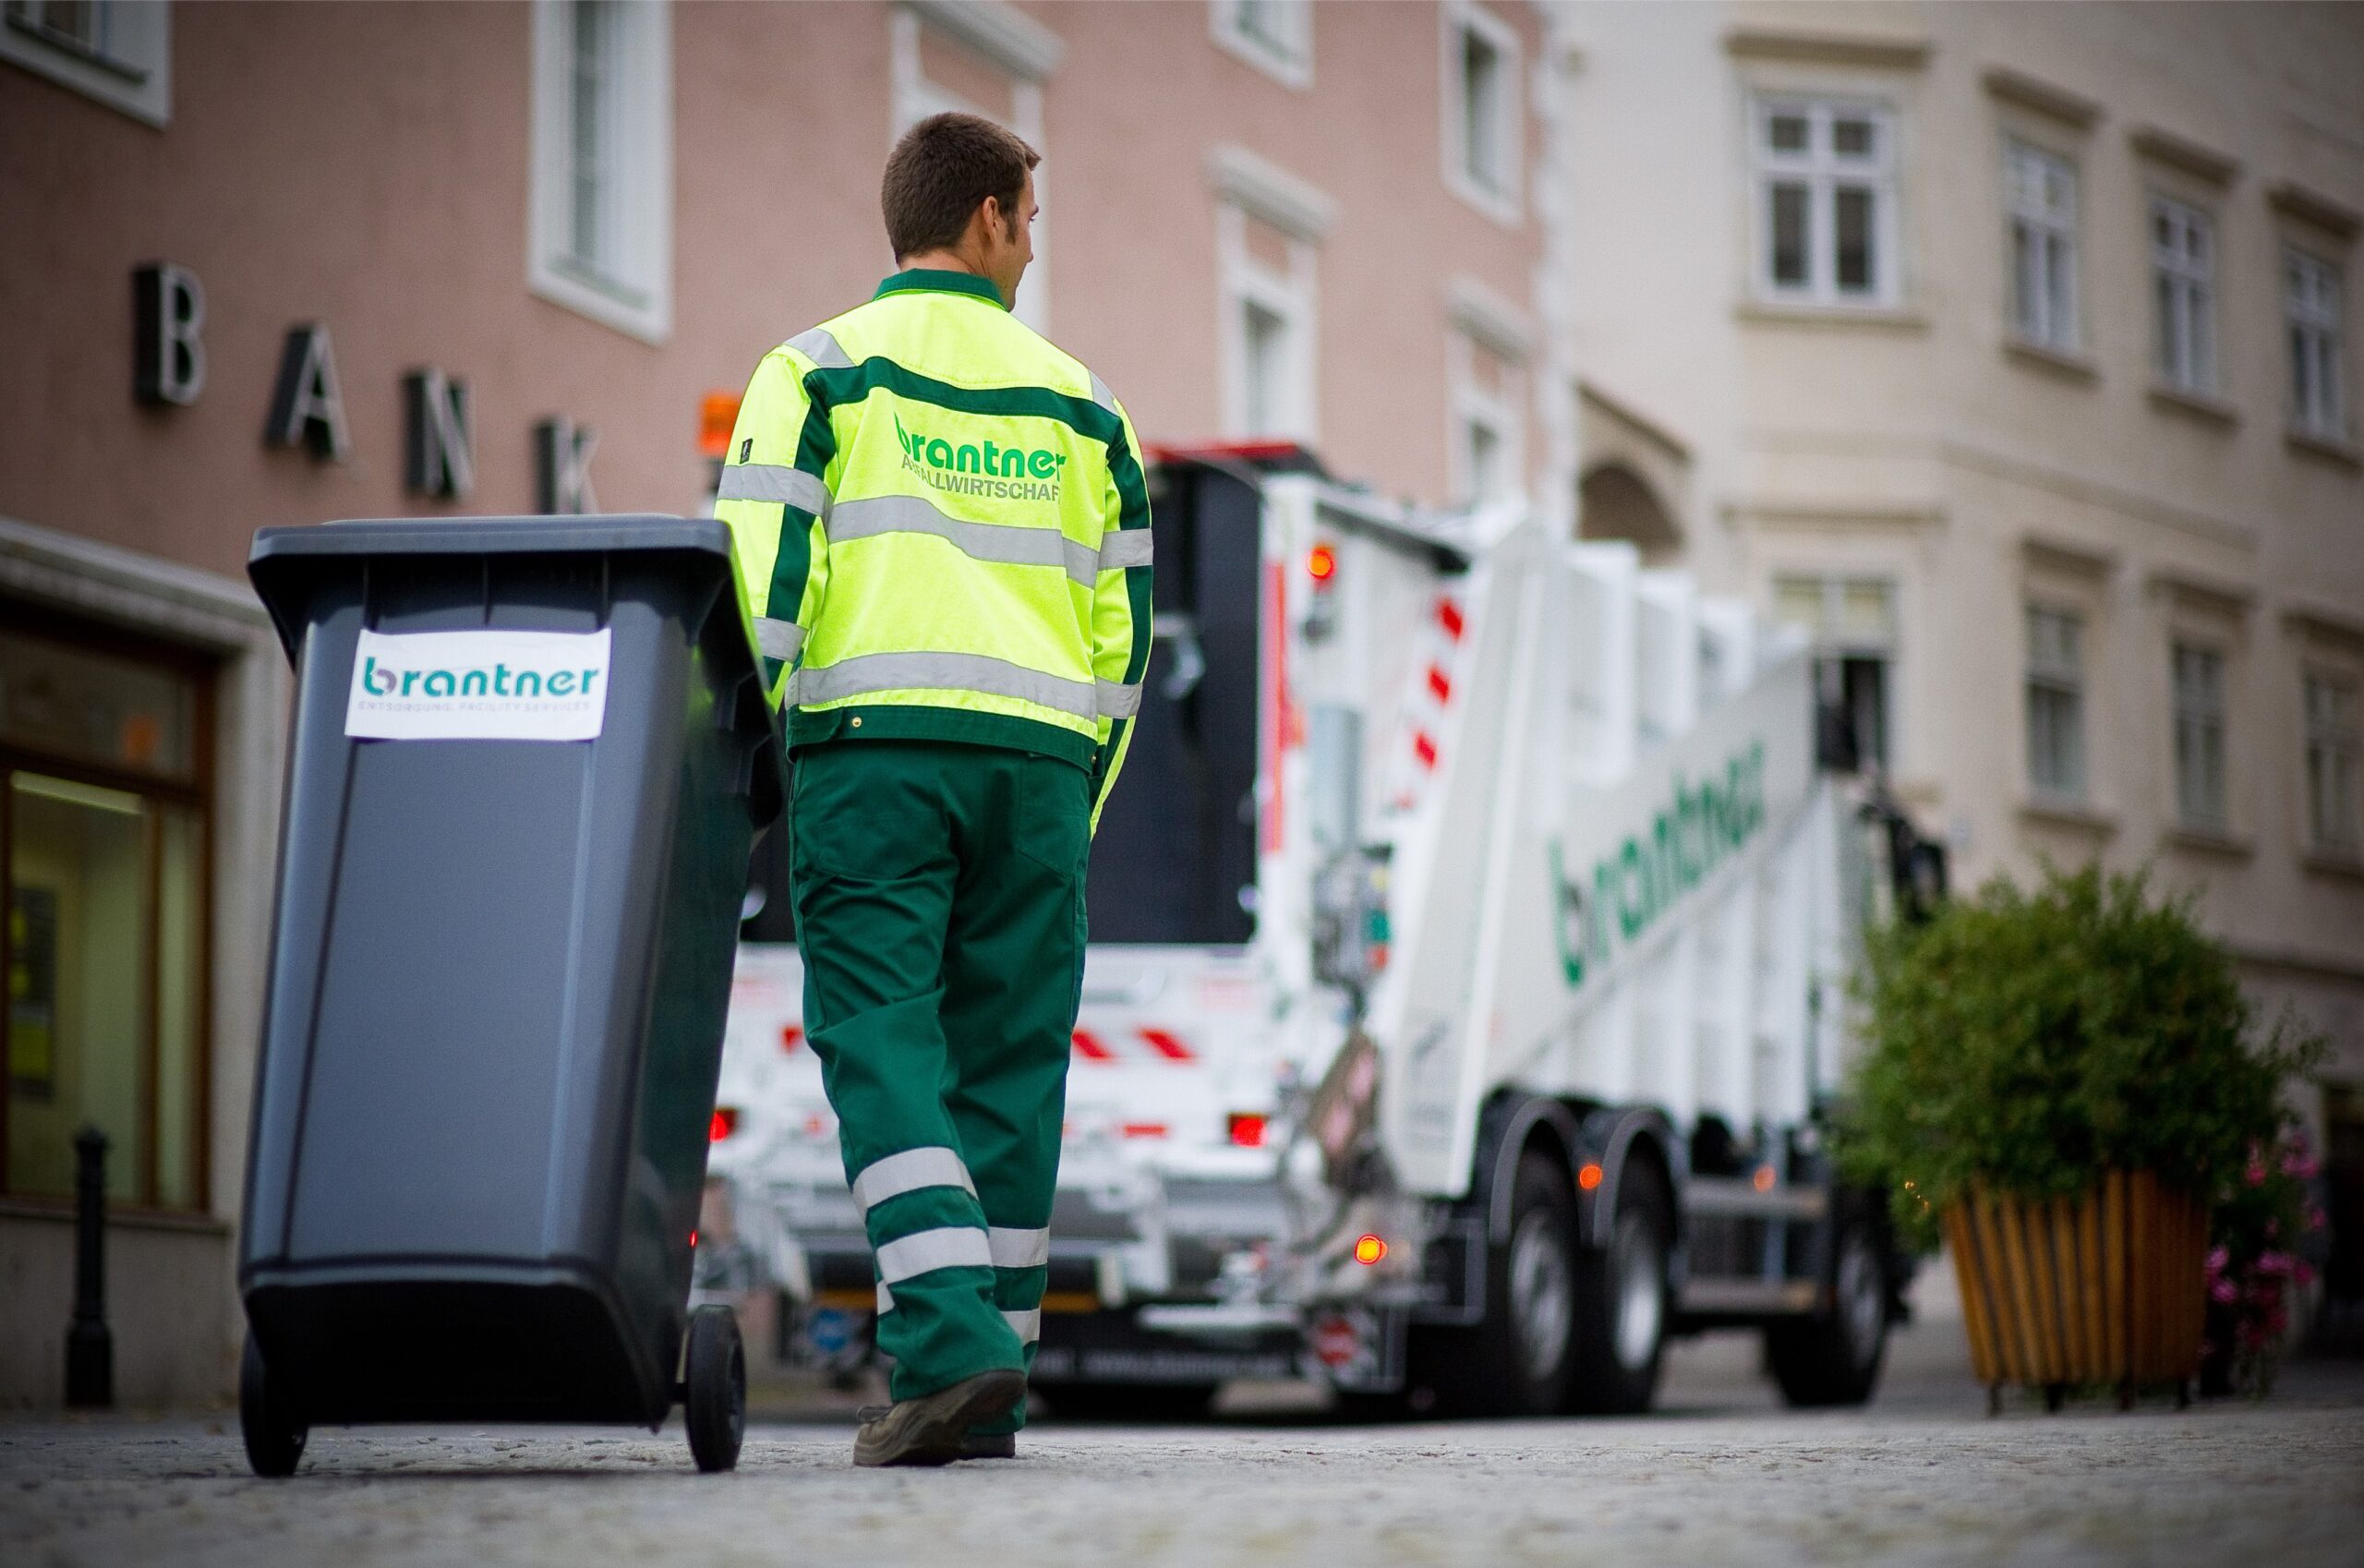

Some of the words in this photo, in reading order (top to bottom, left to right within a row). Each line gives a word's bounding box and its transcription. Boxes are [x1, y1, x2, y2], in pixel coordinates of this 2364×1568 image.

[133, 261, 600, 514] BANK
[894, 412, 1066, 481] brantner
[363, 656, 599, 696] brantner
